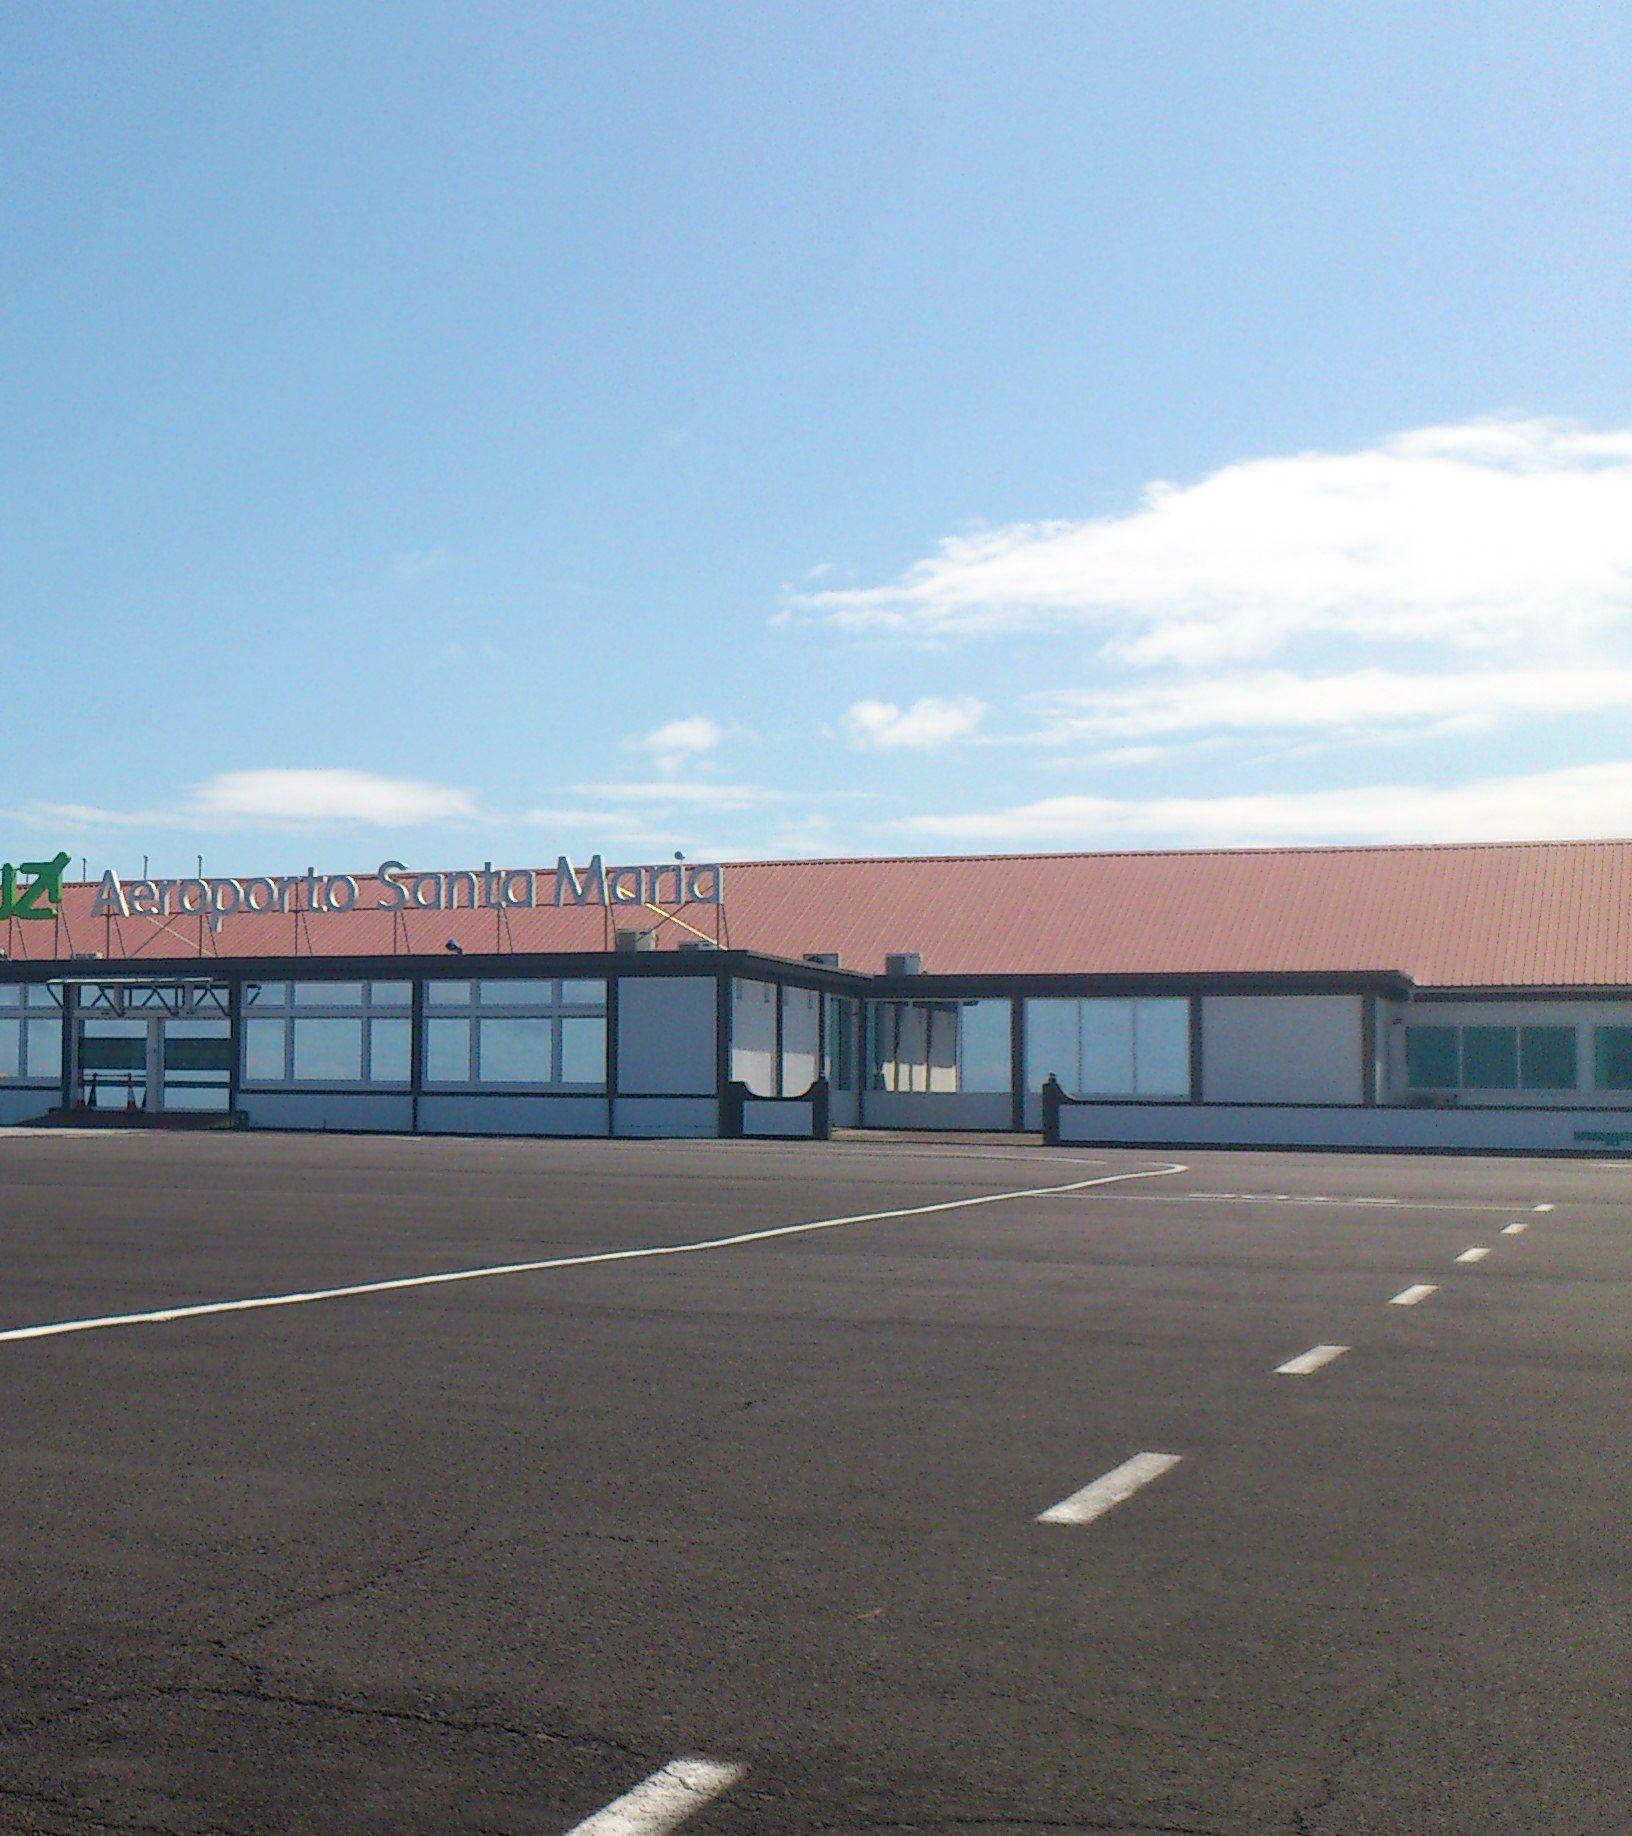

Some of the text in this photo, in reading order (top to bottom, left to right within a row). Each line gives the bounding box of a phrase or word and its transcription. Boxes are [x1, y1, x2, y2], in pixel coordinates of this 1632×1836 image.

[92, 851, 724, 933] Aeroporto Santa Maria
